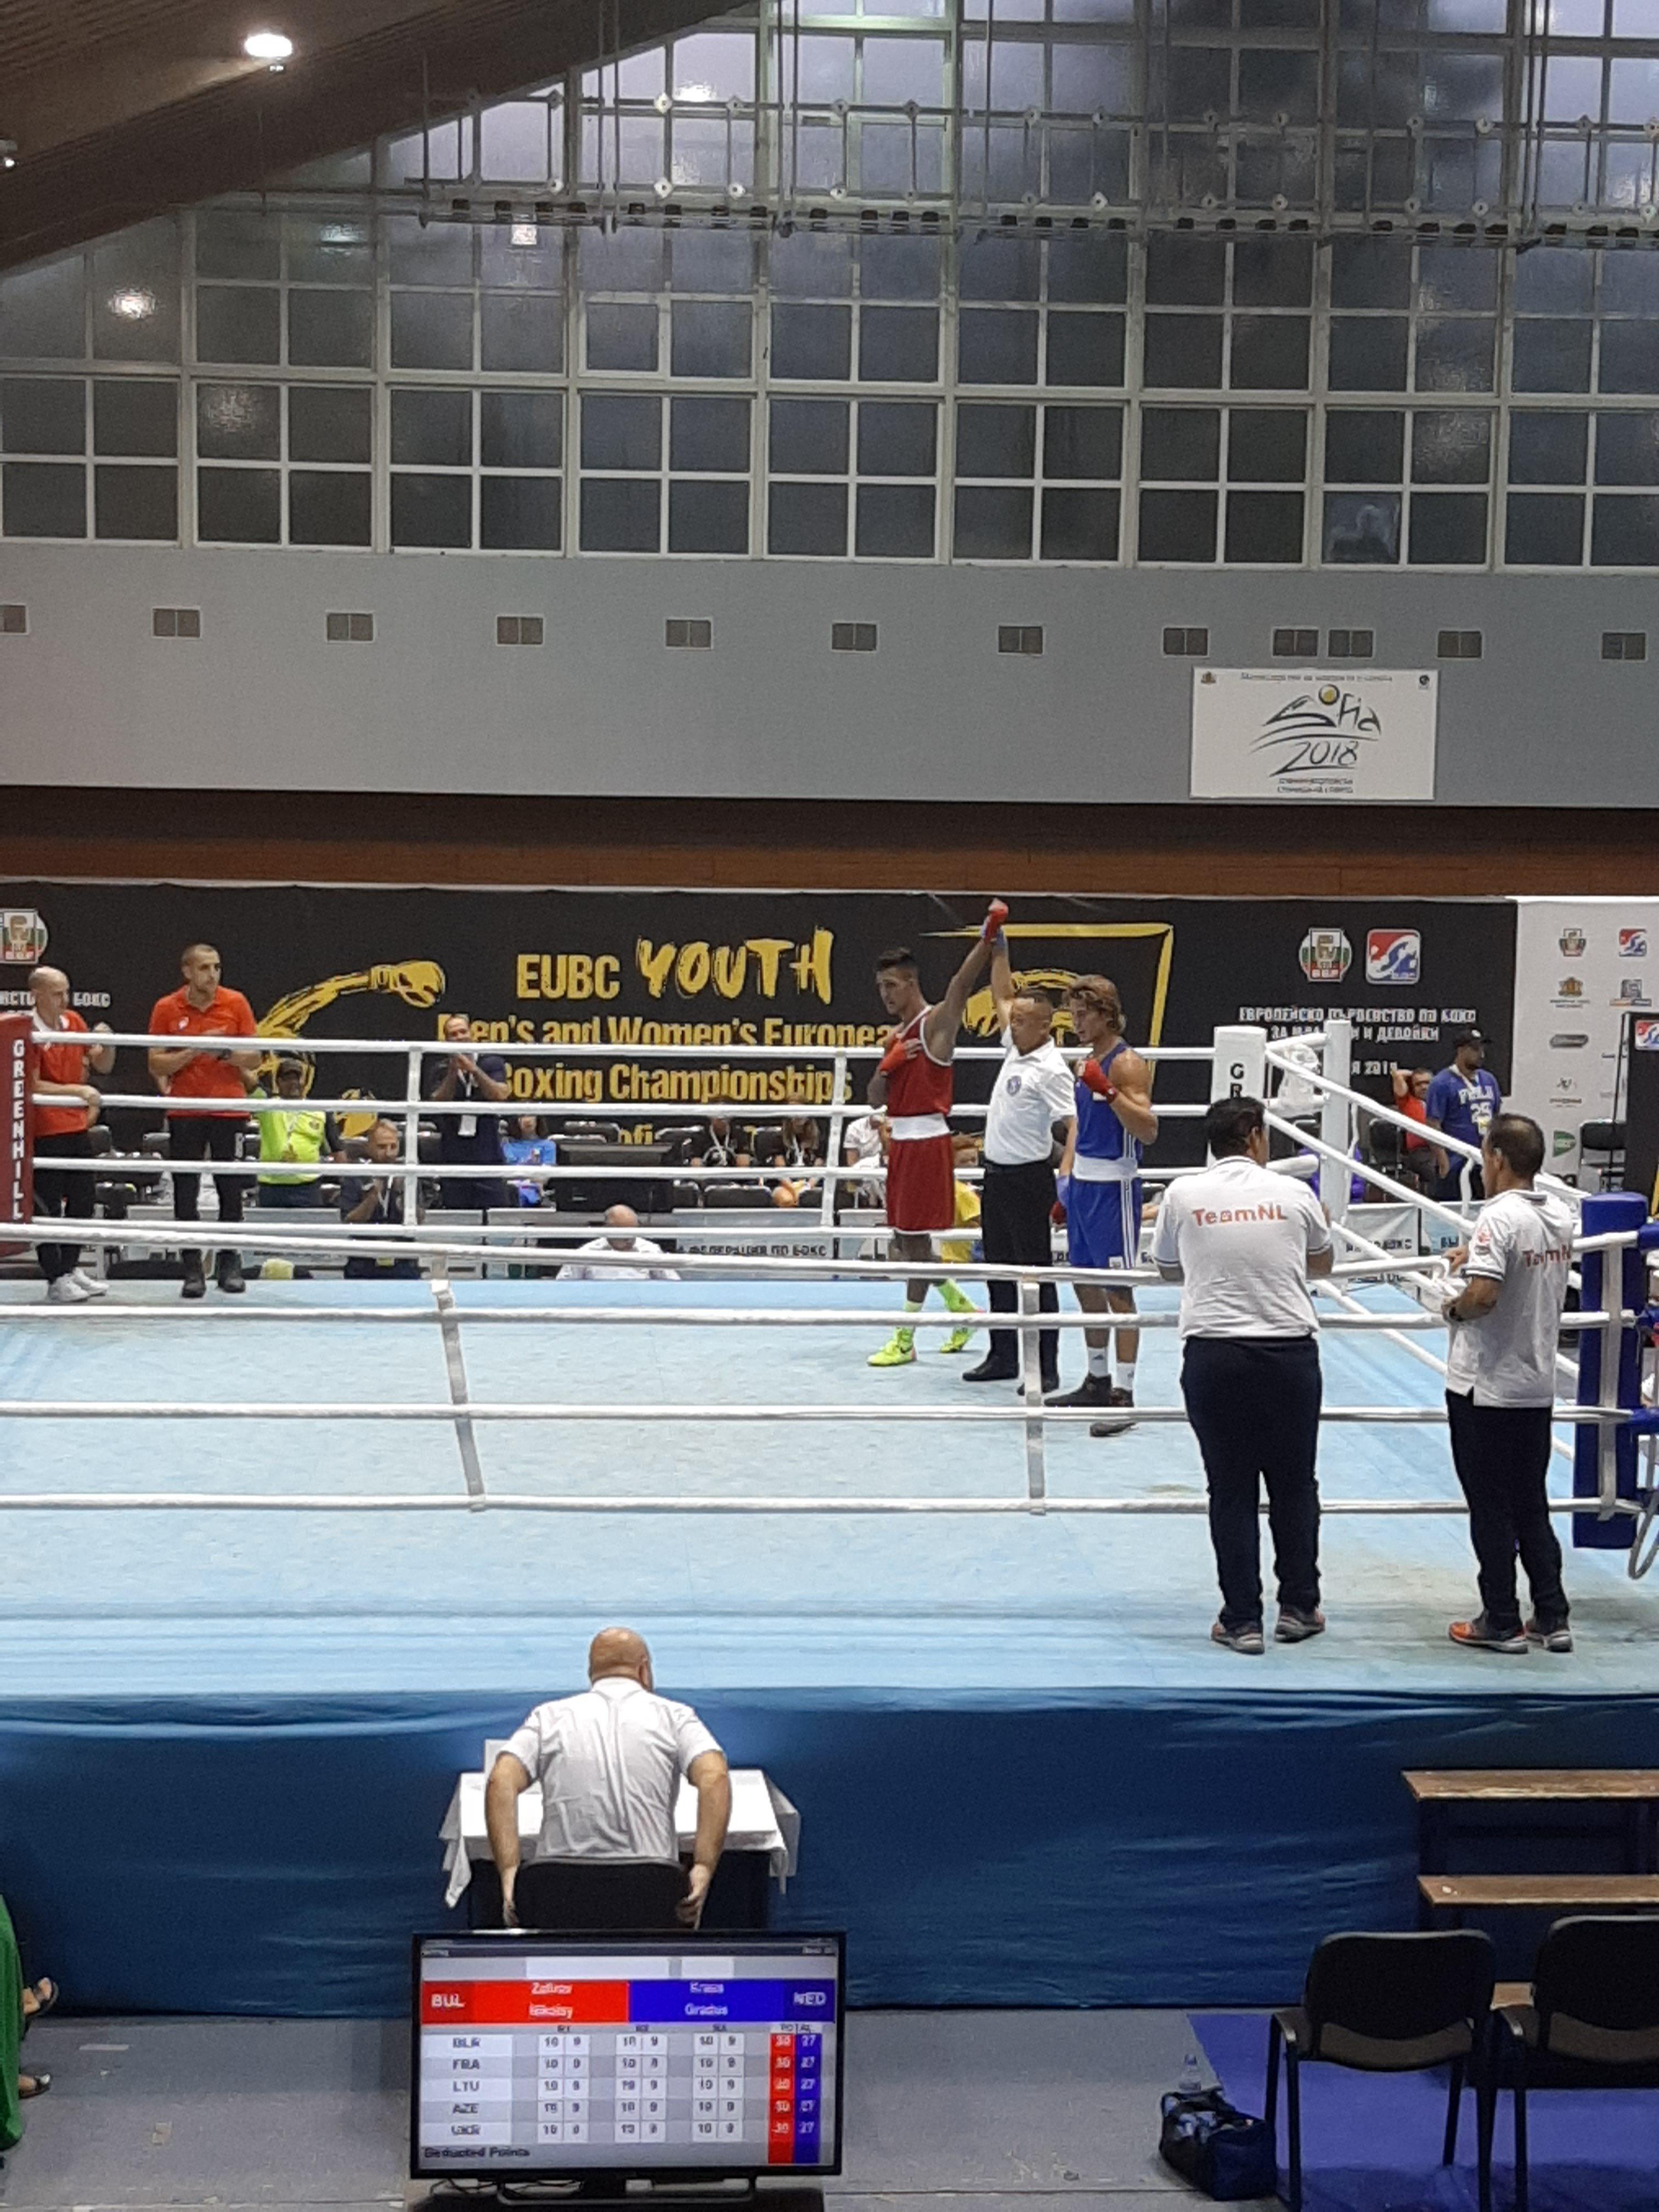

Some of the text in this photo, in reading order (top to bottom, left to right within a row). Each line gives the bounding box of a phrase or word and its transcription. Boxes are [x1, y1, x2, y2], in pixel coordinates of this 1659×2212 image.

[1269, 741, 1359, 777] 2018
[516, 925, 833, 1005] EUBC YOUTH
[542, 1016, 601, 1043] and
[607, 1017, 758, 1045] Women's
[764, 1018, 895, 1046] Europea
[12, 1039, 26, 1221] GREENHILL
[1192, 1202, 1289, 1227] TeamNL
[431, 1993, 466, 2008] BUL
